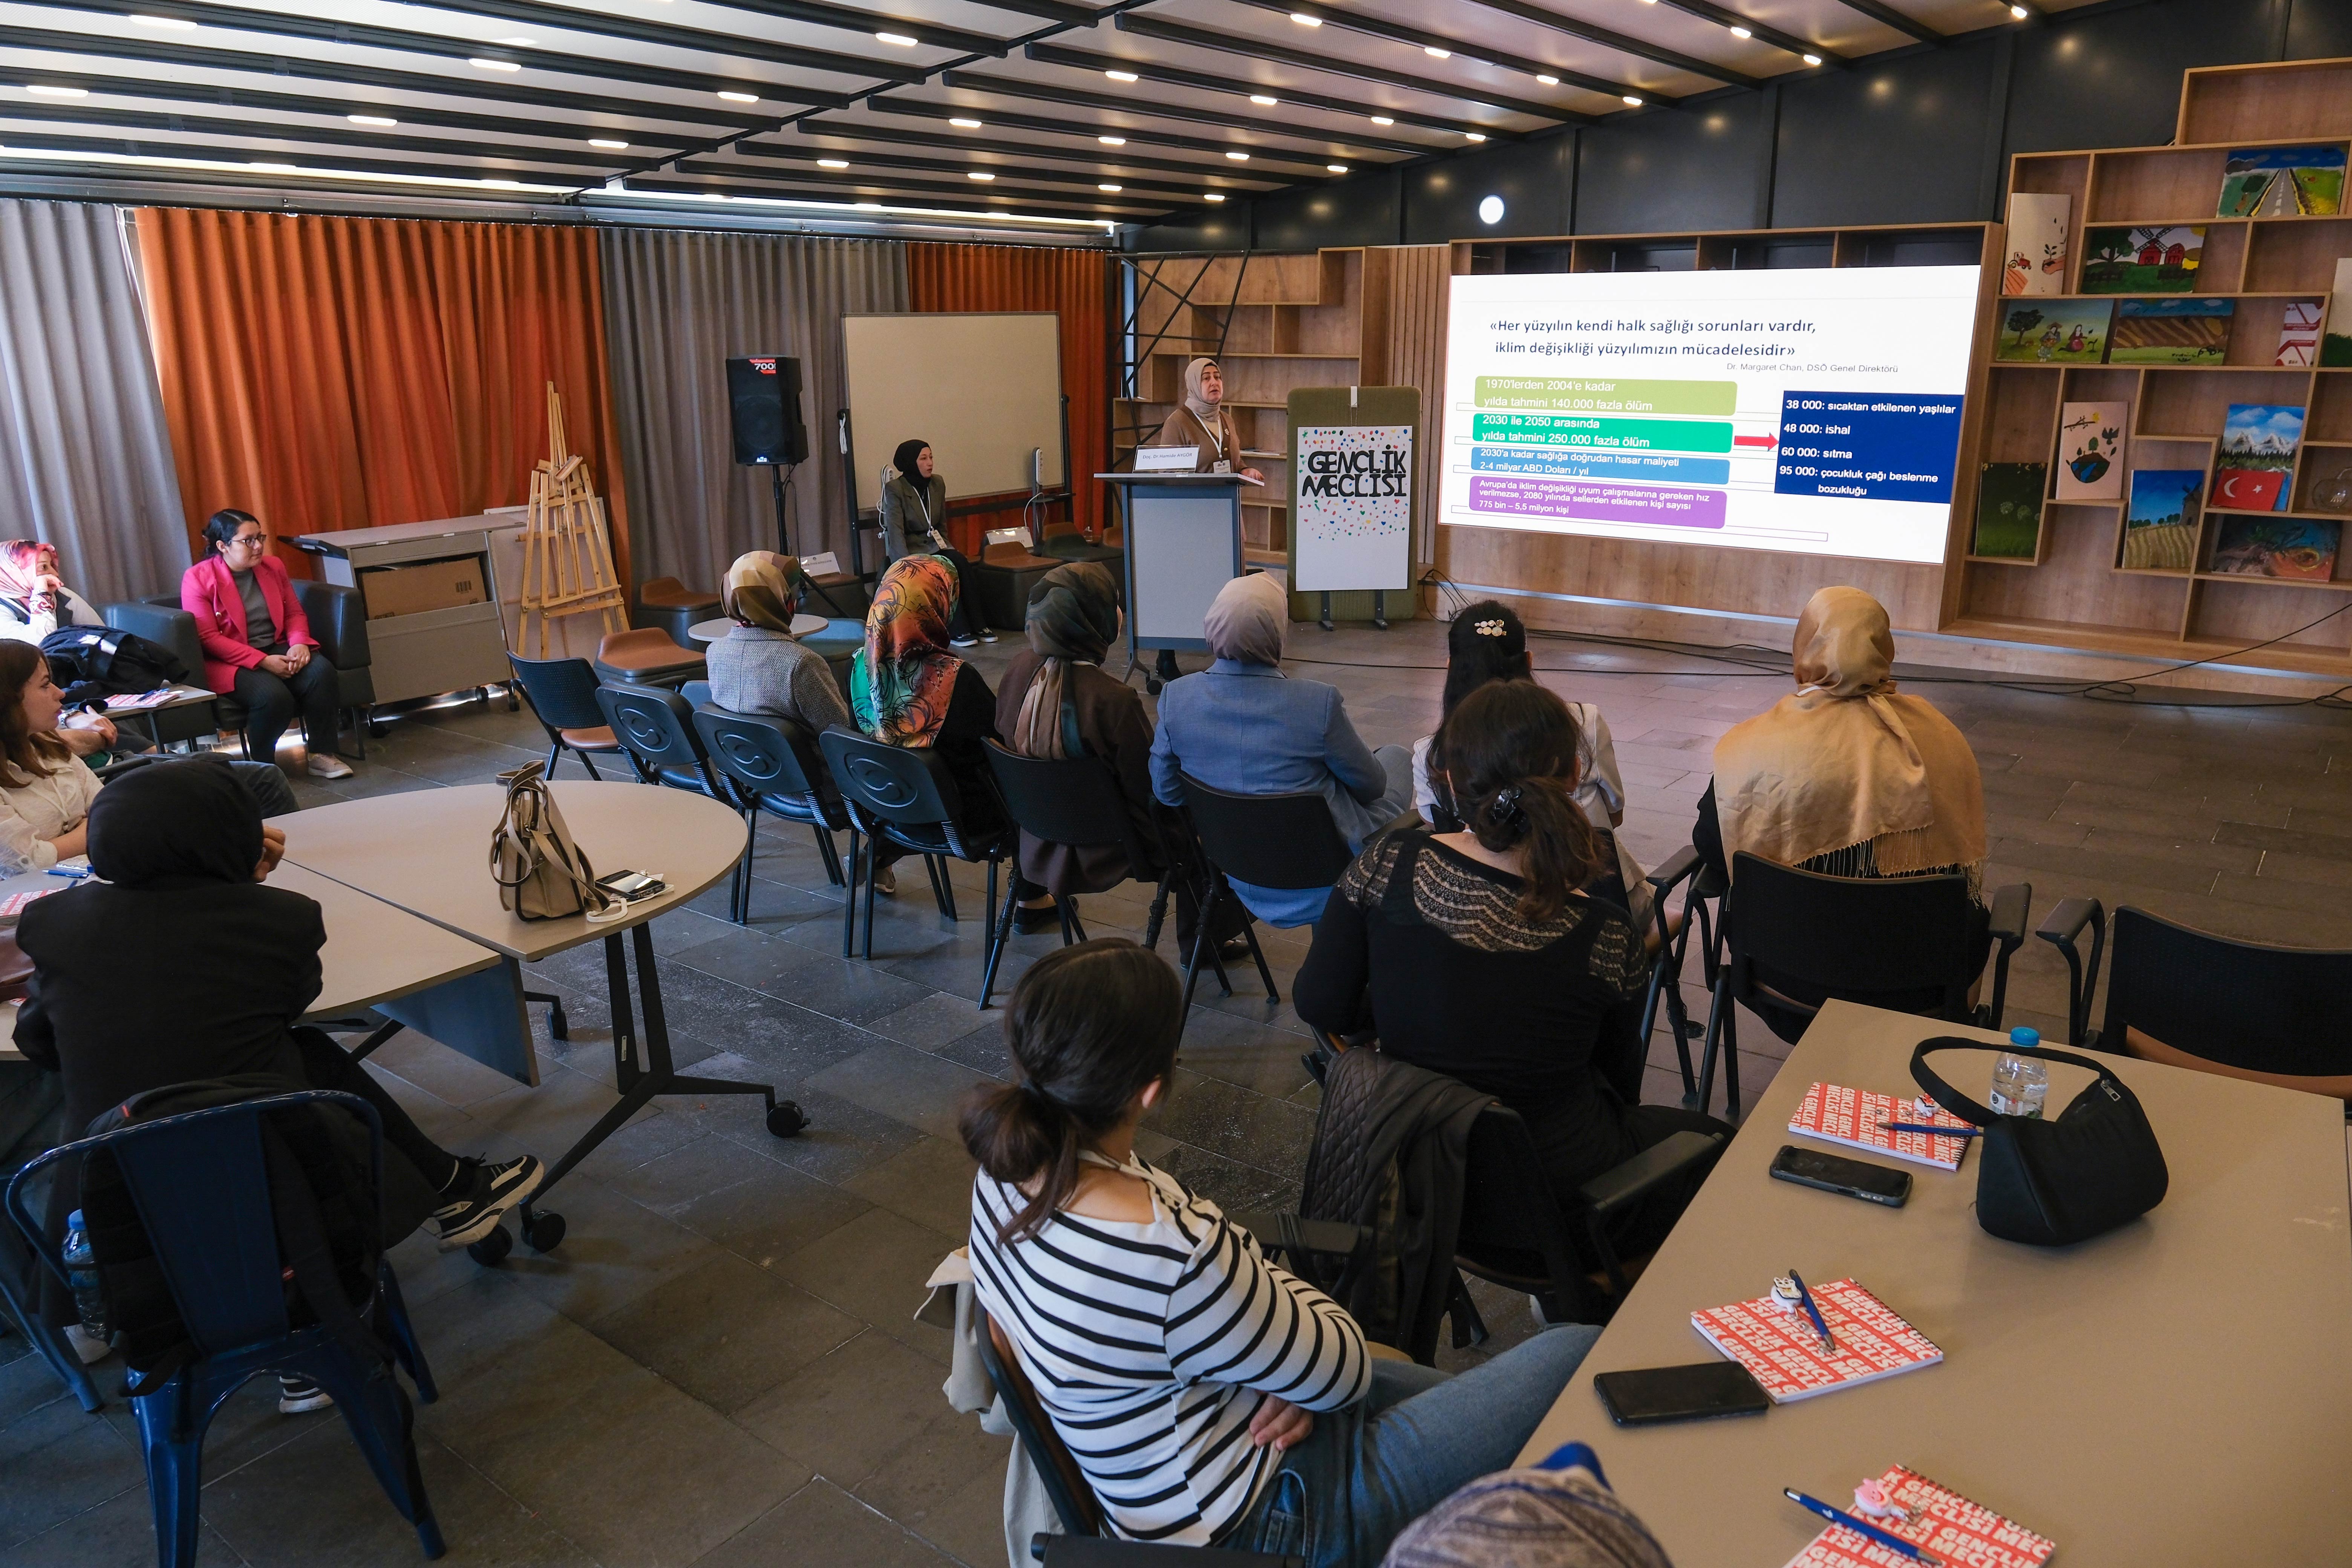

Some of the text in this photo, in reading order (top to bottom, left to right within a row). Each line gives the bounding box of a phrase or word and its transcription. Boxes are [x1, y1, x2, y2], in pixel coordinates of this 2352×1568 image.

[1524, 320, 1572, 333] yüzyılın
[1577, 320, 1612, 331] kendi
[1617, 320, 1646, 331] halk
[1650, 320, 1694, 334] sağlığı
[1698, 320, 1763, 332] sorunları
[1769, 320, 1815, 334] vardır,
[1496, 342, 1795, 356] iklim değişikliği yüzyılımızın mücadelesidir»
[1741, 363, 1776, 372] Margaret
[1780, 364, 1804, 372] Chan,
[1486, 379, 1616, 391] 1970'lerden 2004'e kadar
[1484, 397, 1652, 411] yılda tahmini 140.000 fazla ölüm
[1786, 400, 1956, 415] 38 000: sıcaktan etkilenen yaşlılar
[1483, 415, 1600, 429] 2030 ile 2050 arasında
[1784, 423, 1851, 435] 48 000: ishal
[1482, 431, 1650, 447] yılda tahmini 250.000 fazla ölüm
[1481, 448, 1679, 467] 2030'a kadar sağlığa doğrudan hasar maliyeti
[1781, 447, 1853, 459] 60 000: sıtma
[1496, 462, 1521, 472] milyar
[1545, 465, 1571, 474] Doları
[1579, 467, 1589, 476] yıl
[1779, 465, 1938, 482] 95 000: çocukluk çağı beslenme
[1479, 479, 1517, 489] Avrupa'da
[1539, 483, 1576, 494] değişikliği
[1603, 488, 1657, 498] çalışmalarına
[1659, 492, 1694, 501] gereken
[1697, 493, 1710, 502] hız
[1818, 484, 1867, 497] bozukluğu
[1479, 490, 1691, 511] verilmezse, 2080 yılında sellerden etkilenen kişi sayısı
[1479, 500, 1493, 508] 775
[1515, 503, 1527, 511] 5,5
[1529, 504, 1554, 513] milyon
[1556, 506, 1569, 514] kişi
